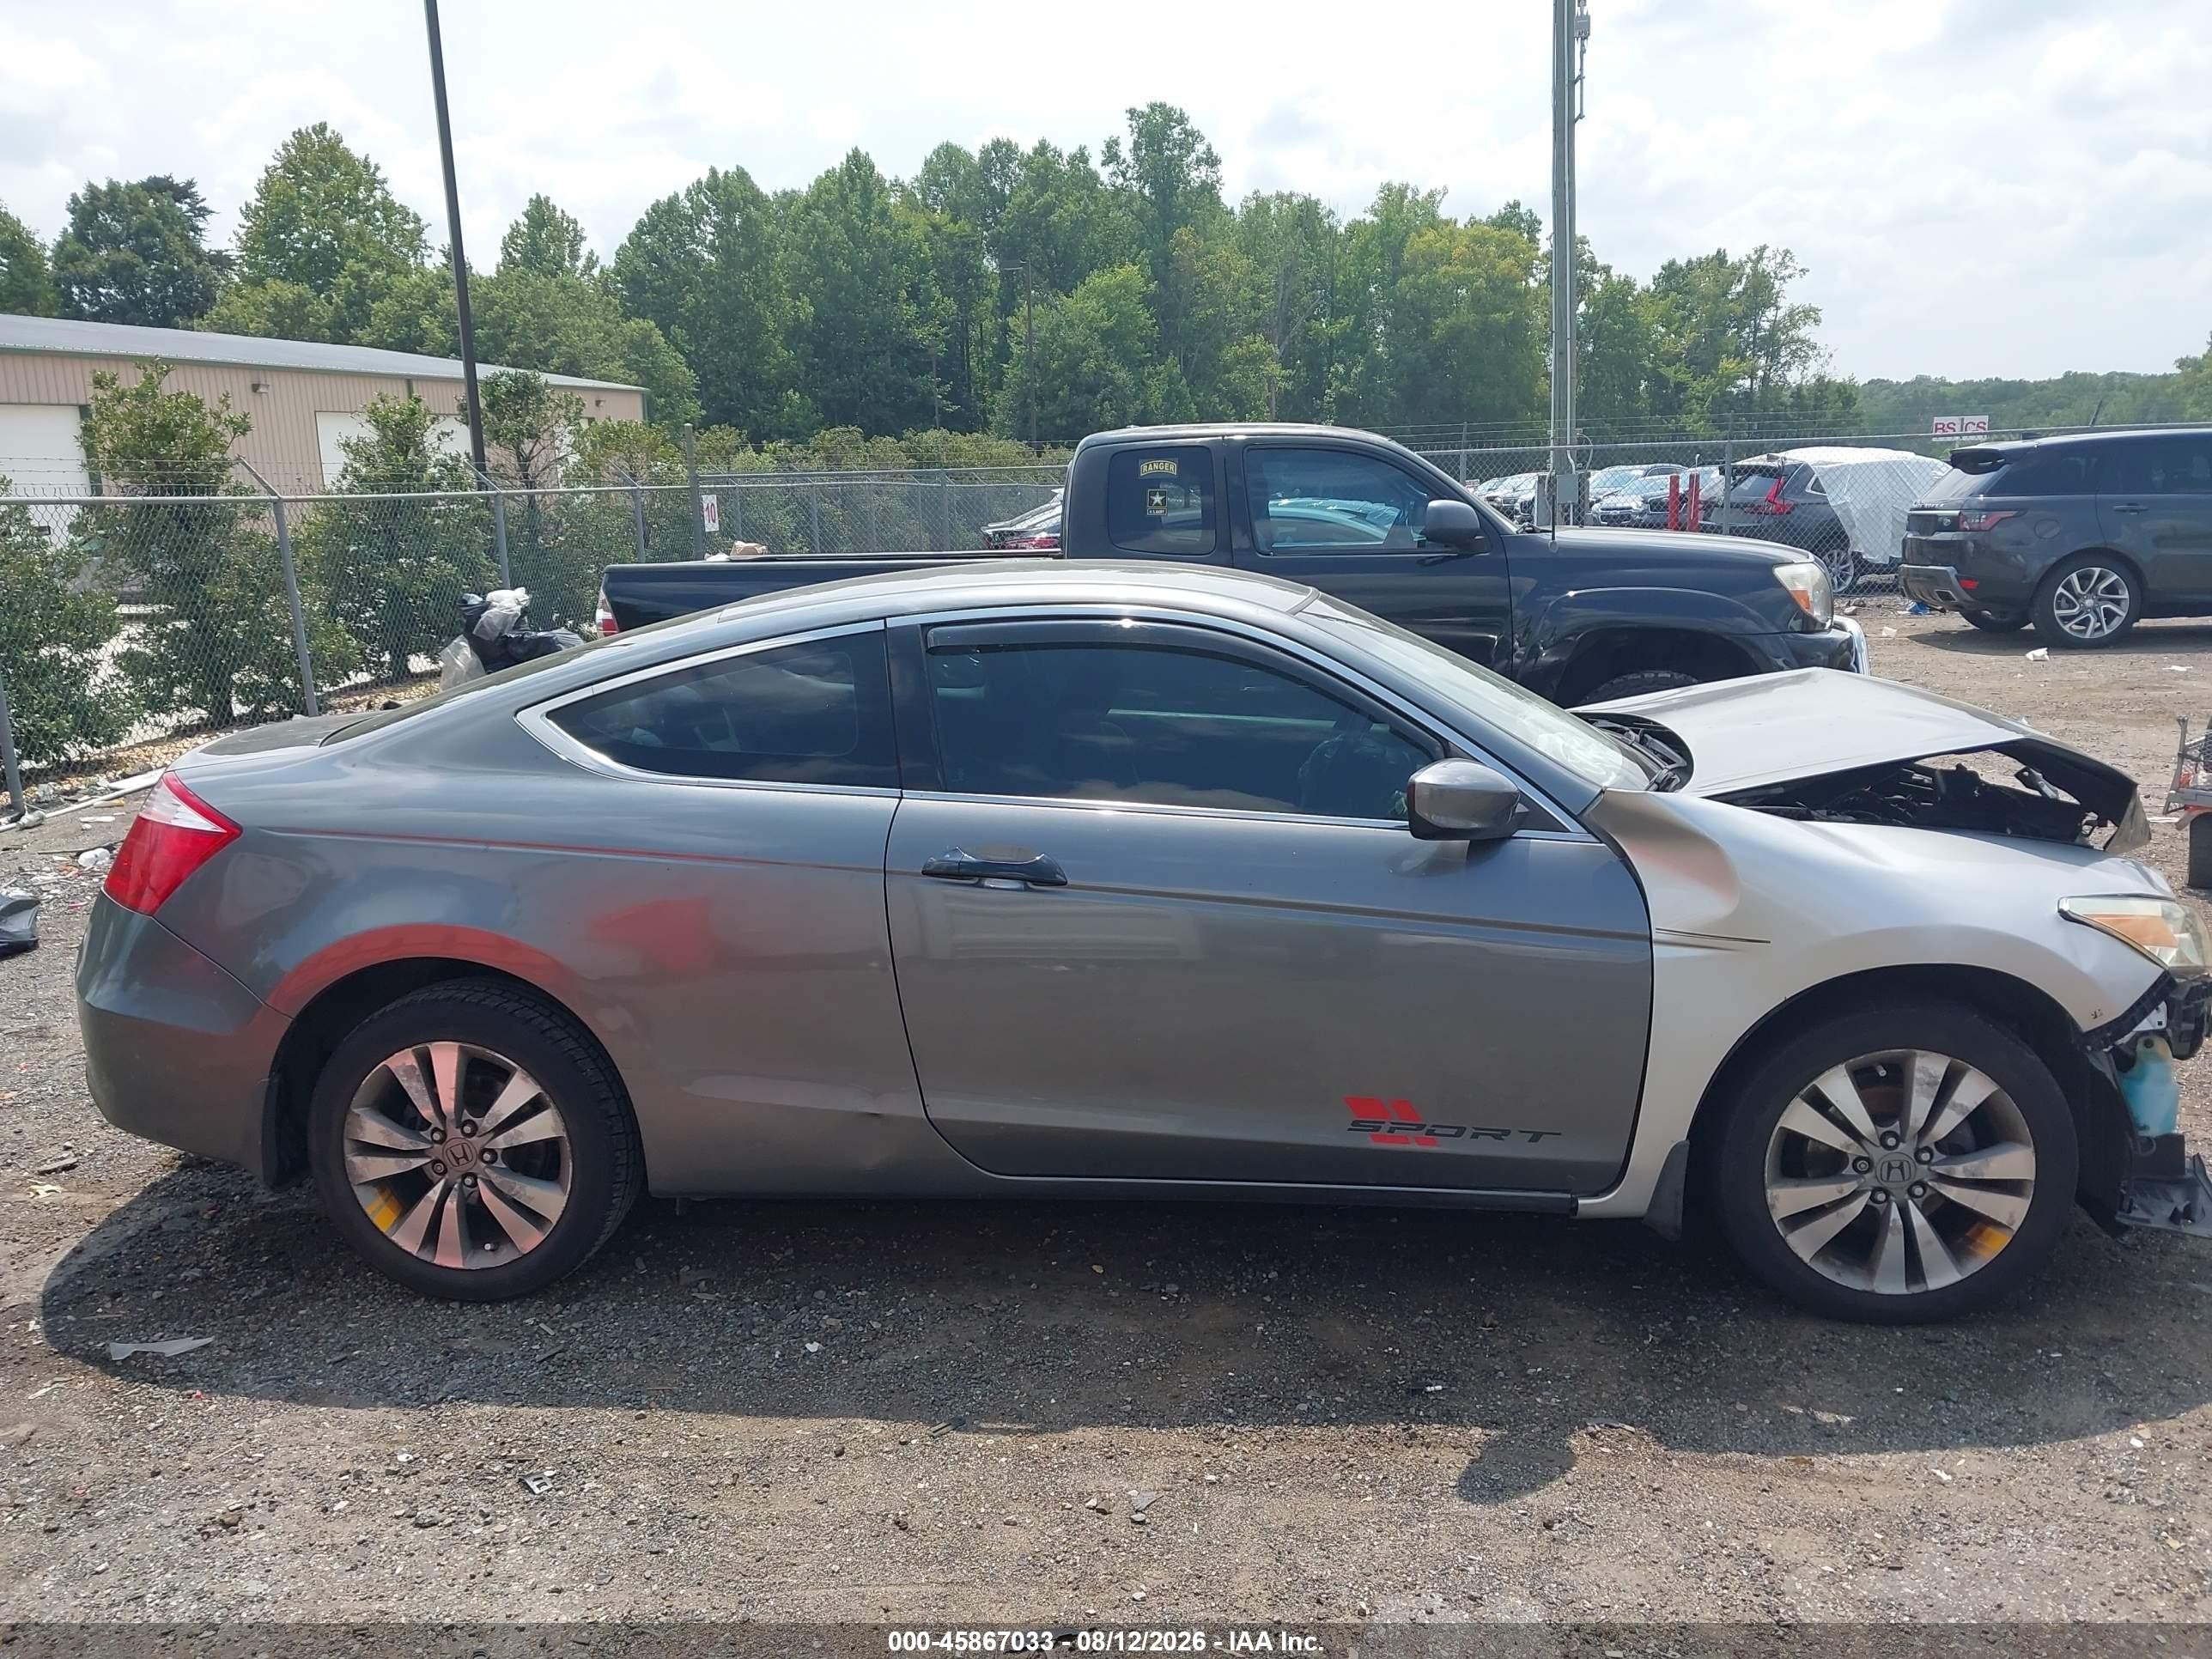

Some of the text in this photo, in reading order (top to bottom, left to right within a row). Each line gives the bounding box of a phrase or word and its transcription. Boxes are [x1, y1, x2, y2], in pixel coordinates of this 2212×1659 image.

[1142, 462, 1175, 472] RANGER
[705, 502, 716, 523] 10
[1346, 1119, 1562, 1143] SPORT
